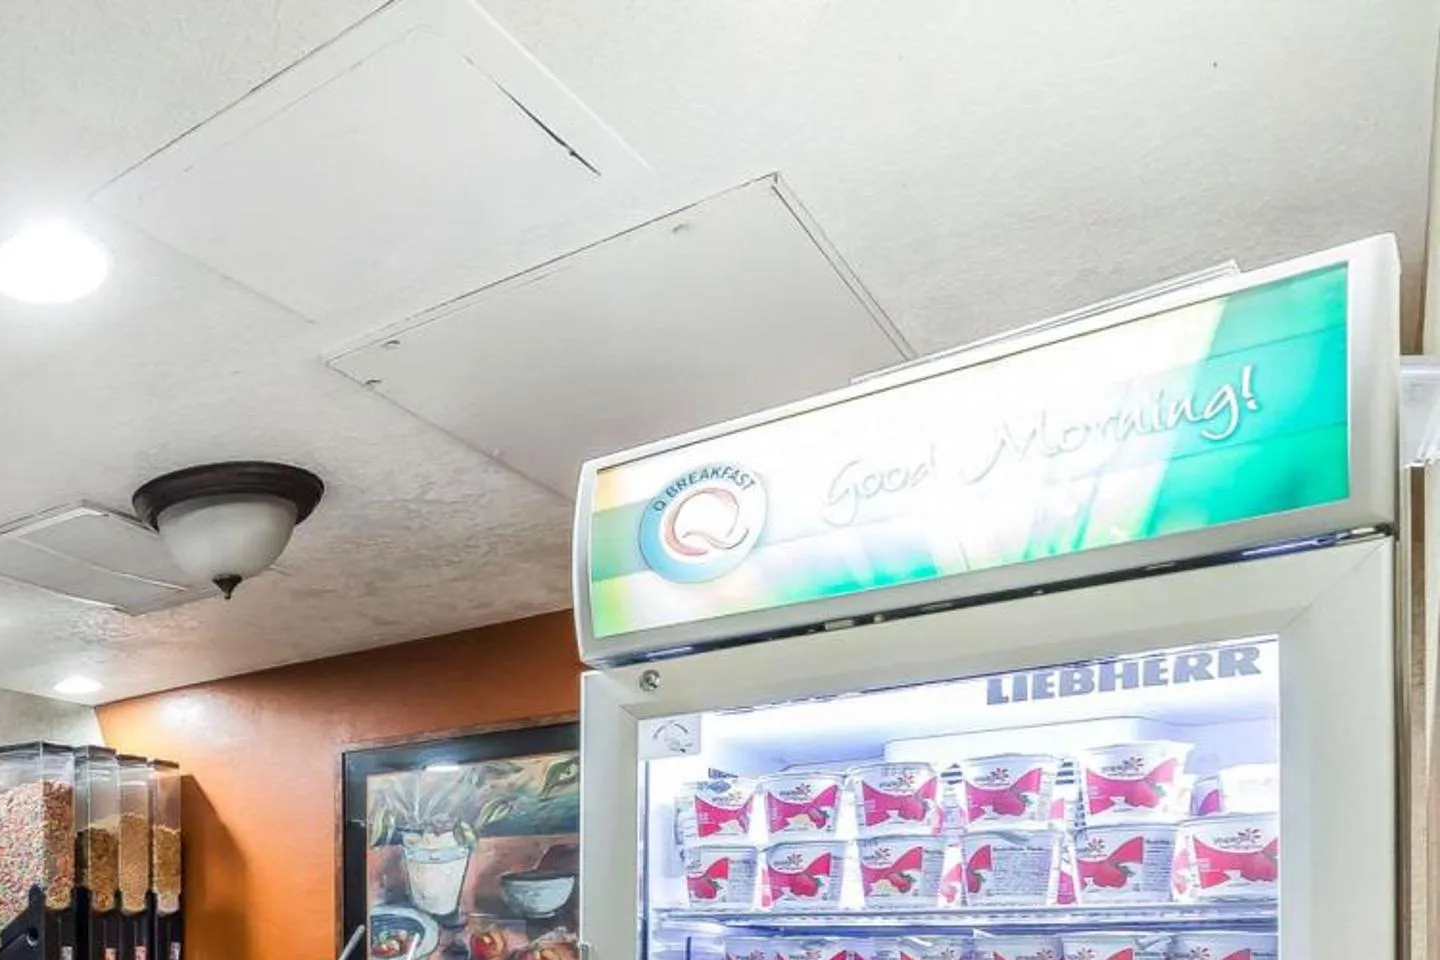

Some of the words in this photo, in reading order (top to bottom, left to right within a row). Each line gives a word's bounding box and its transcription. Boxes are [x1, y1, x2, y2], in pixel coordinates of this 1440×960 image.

[822, 444, 936, 528] Good
[963, 365, 1258, 485] Morning!
[665, 466, 756, 498] BREAKFAST
[986, 646, 1261, 705] LIEBHERR
